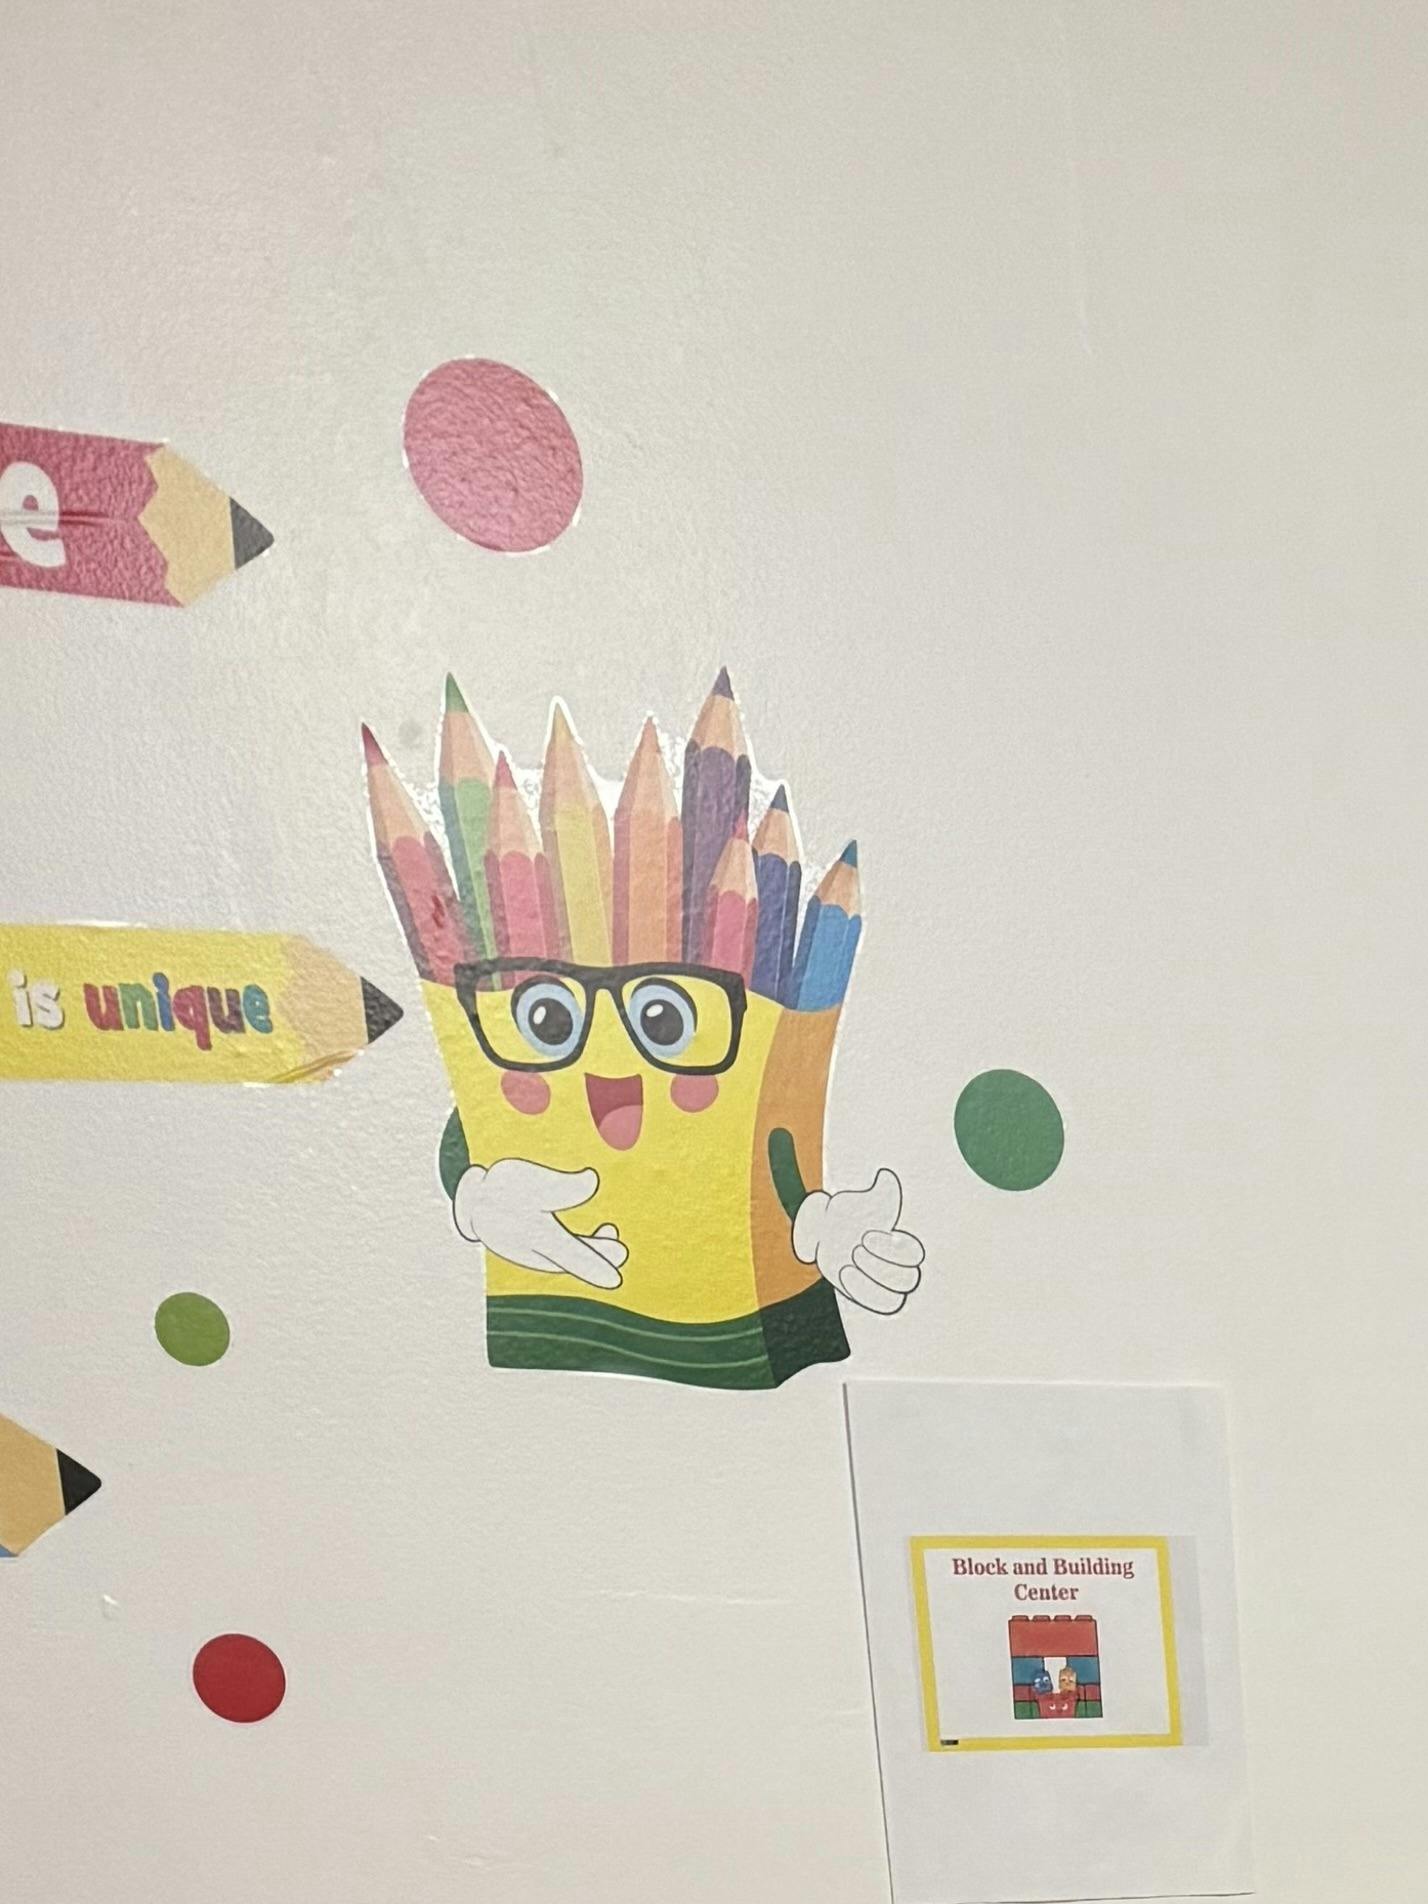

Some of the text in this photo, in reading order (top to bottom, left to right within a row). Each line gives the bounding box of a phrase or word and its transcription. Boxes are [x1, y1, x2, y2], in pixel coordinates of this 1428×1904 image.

[11, 969, 273, 1051] is unique
[952, 1558, 1134, 1579] Block and Building
[1014, 1583, 1079, 1601] Center
